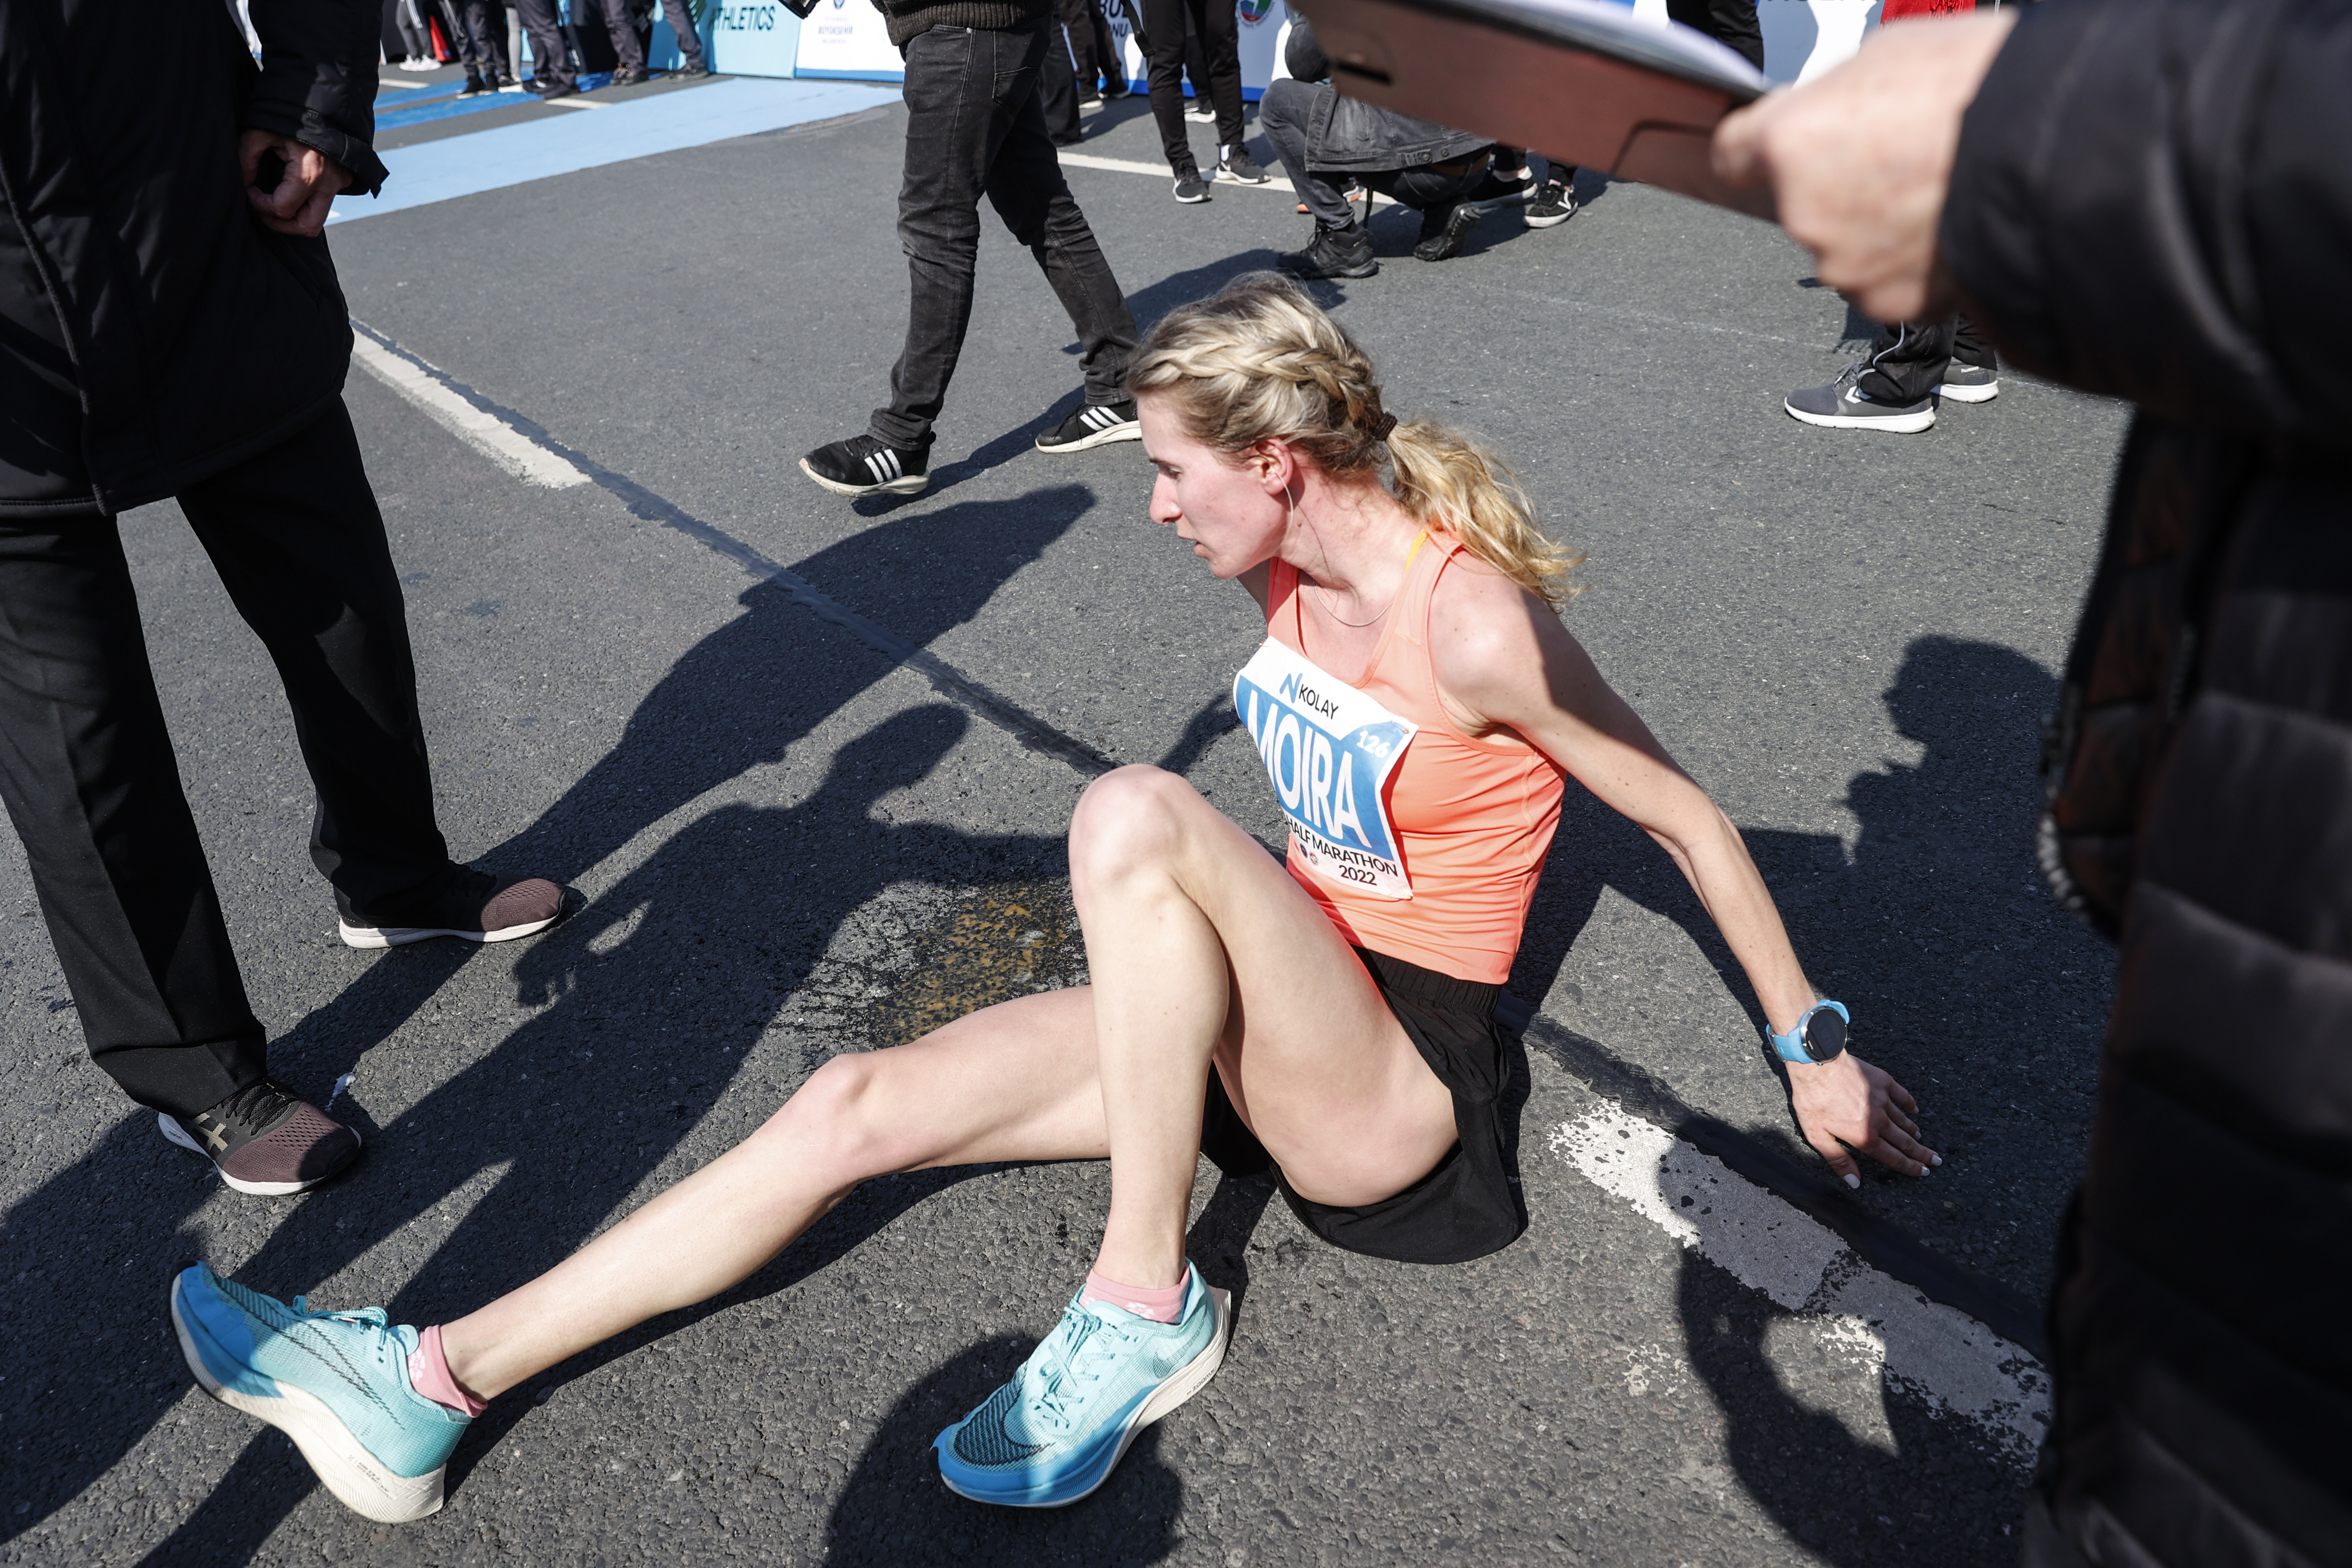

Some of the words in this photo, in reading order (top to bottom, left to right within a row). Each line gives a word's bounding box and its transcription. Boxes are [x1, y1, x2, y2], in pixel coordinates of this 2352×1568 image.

[707, 6, 776, 31] ATHLETICS
[1357, 730, 1391, 758] 126
[1247, 689, 1372, 848] MOIRA
[1338, 864, 1378, 886] 2022
